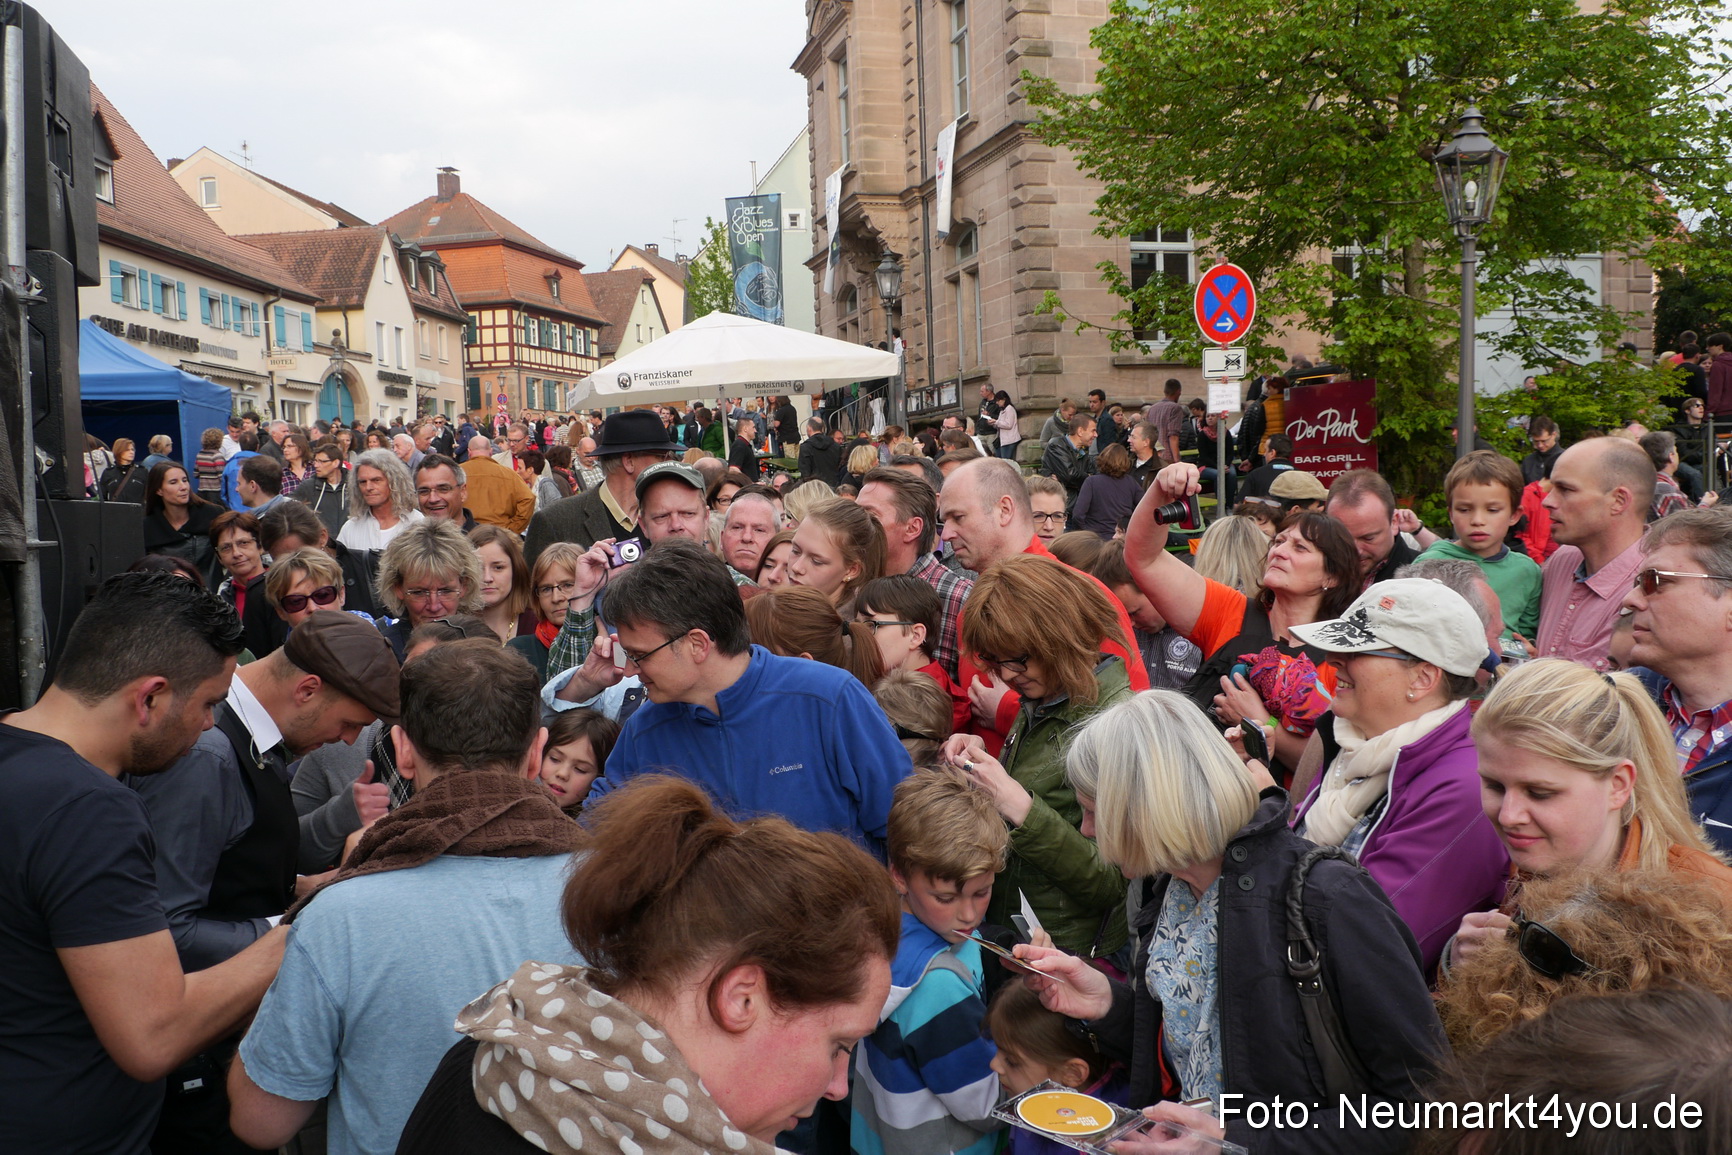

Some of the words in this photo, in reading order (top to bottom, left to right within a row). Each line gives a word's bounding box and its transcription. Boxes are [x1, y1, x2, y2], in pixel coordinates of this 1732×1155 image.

[735, 202, 764, 216] Jazz
[743, 216, 774, 232] Blues
[737, 231, 765, 248] Open
[127, 323, 148, 342] AM
[149, 328, 200, 353] RATHAUS
[633, 369, 693, 381] Franziskaner
[649, 379, 680, 387] WEISSBIER
[1285, 417, 1320, 441] Der
[1317, 408, 1371, 444] Park
